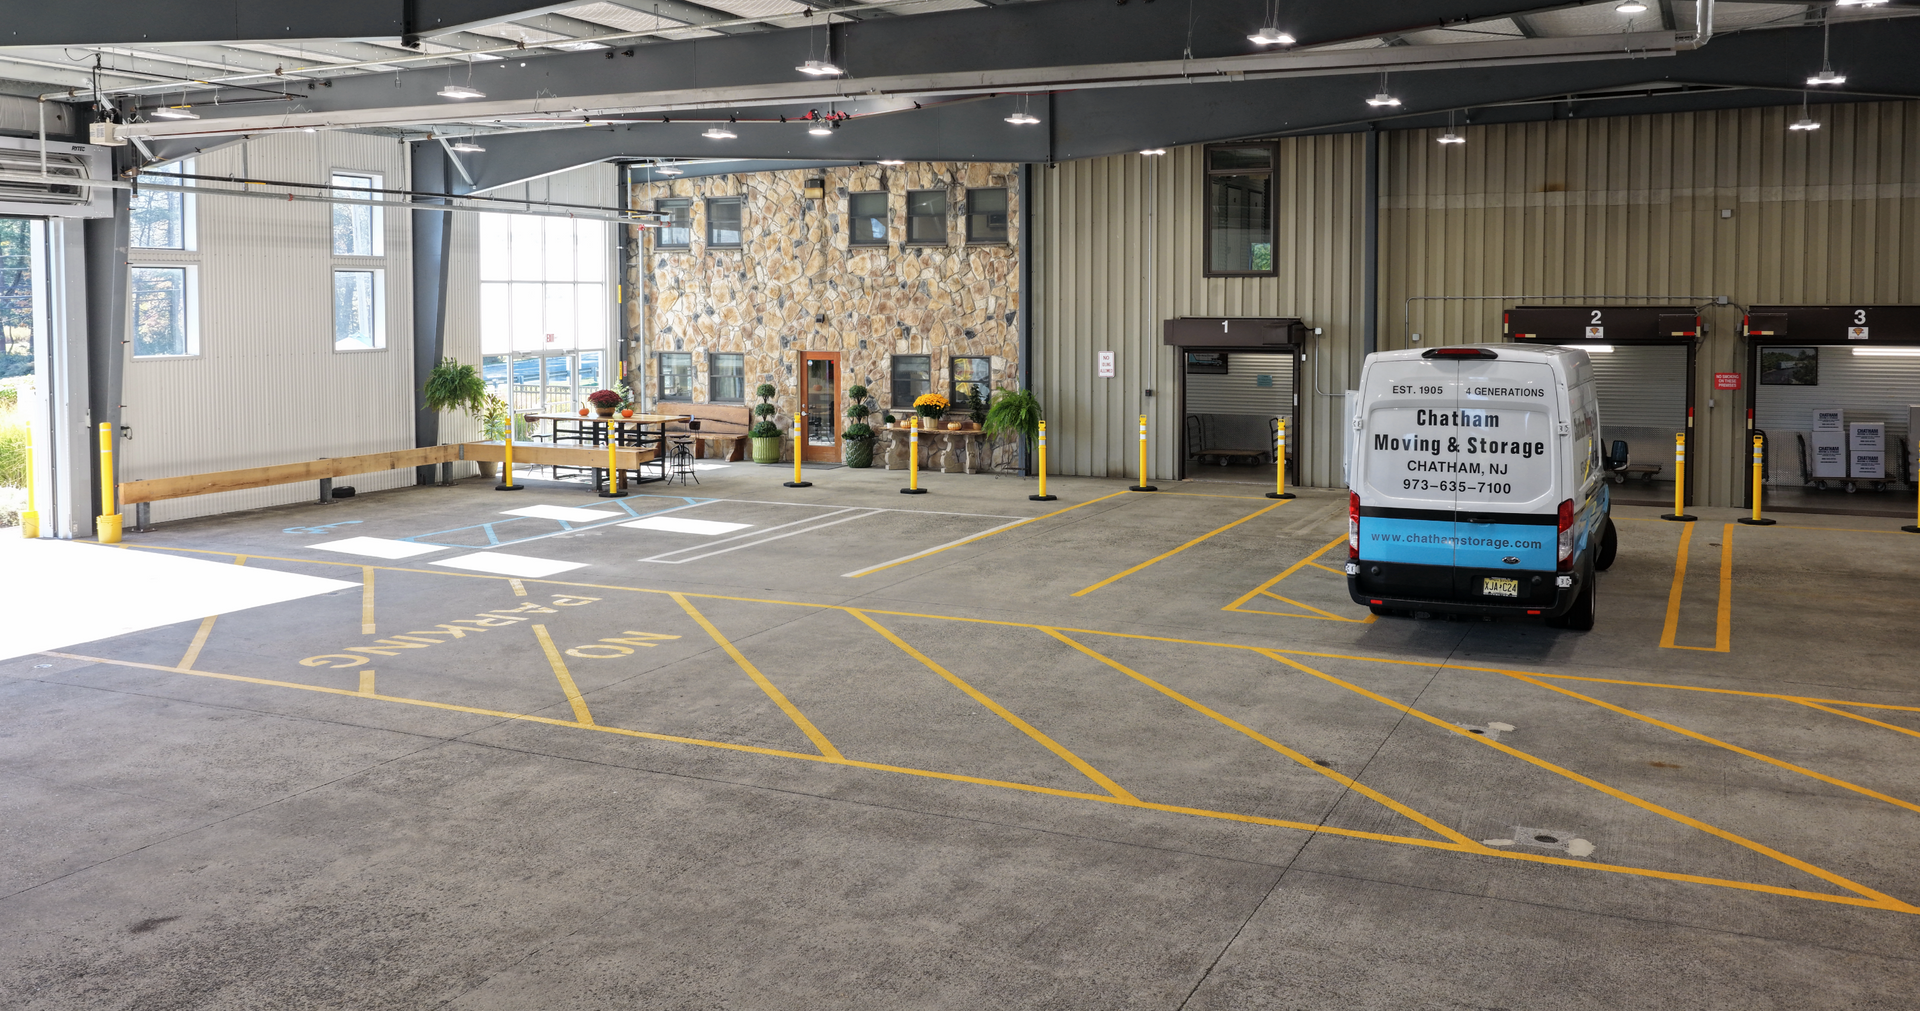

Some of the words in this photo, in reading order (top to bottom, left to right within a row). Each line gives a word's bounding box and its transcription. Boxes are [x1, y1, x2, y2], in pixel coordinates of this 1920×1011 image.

[1590, 309, 1602, 325] 2
[1853, 309, 1866, 325] 3
[1221, 320, 1229, 334] 1
[1392, 385, 1416, 394] EST.
[1419, 386, 1443, 395] 1905
[1465, 387, 1471, 395] 4
[1474, 387, 1545, 397] GENERATIONS
[1416, 409, 1500, 428] Chatham
[1374, 434, 1441, 456] Moving
[1447, 437, 1460, 453] &
[1467, 437, 1545, 459] Storage
[1407, 460, 1485, 476] CHATHAM,
[1489, 463, 1508, 475] NJ
[1403, 478, 1511, 494] 973-635-7100
[1371, 532, 1542, 550] www.chathamstorage.com
[298, 593, 603, 669] PARKING
[564, 630, 682, 659] NO
